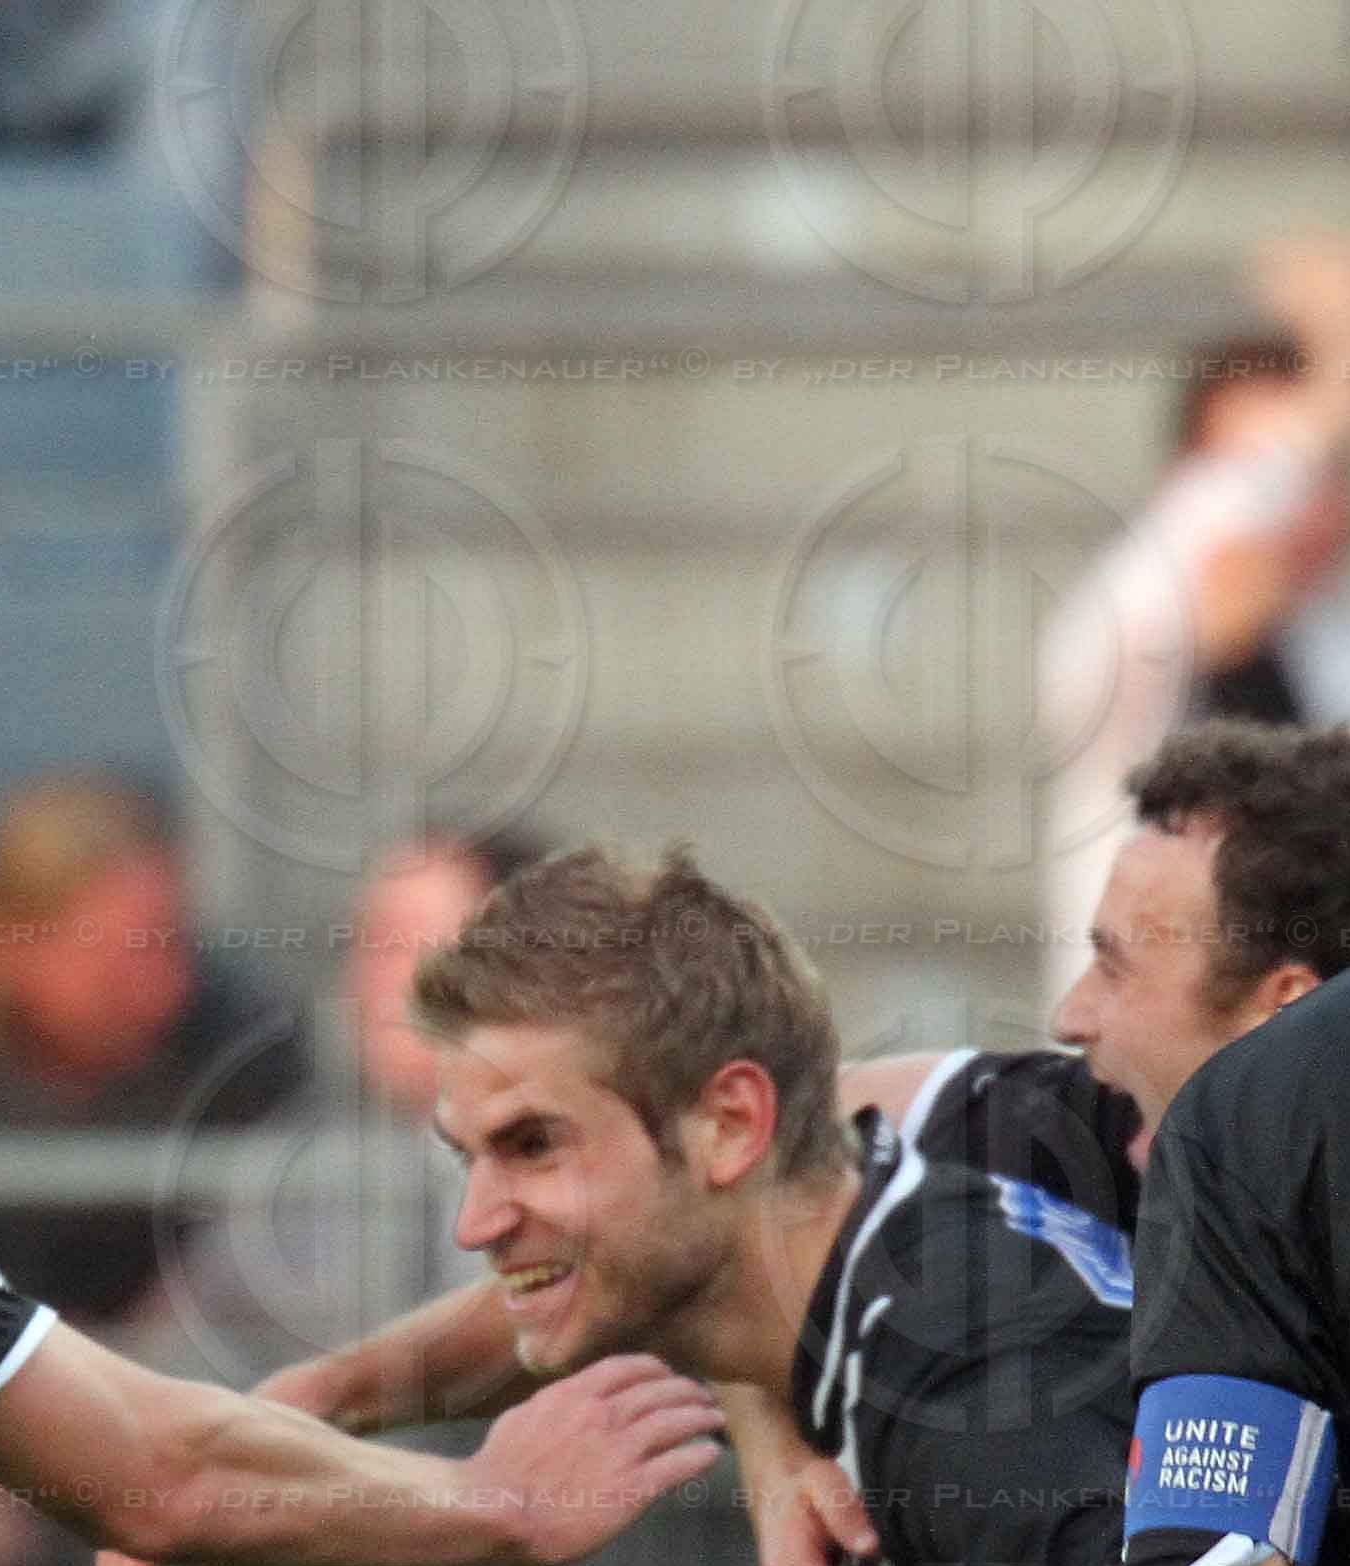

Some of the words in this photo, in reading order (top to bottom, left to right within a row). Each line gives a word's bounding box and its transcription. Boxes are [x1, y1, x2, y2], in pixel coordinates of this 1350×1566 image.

[1164, 1418, 1260, 1451] UNITE
[1161, 1445, 1254, 1473] AGAINST
[1159, 1467, 1249, 1498] RACISM
